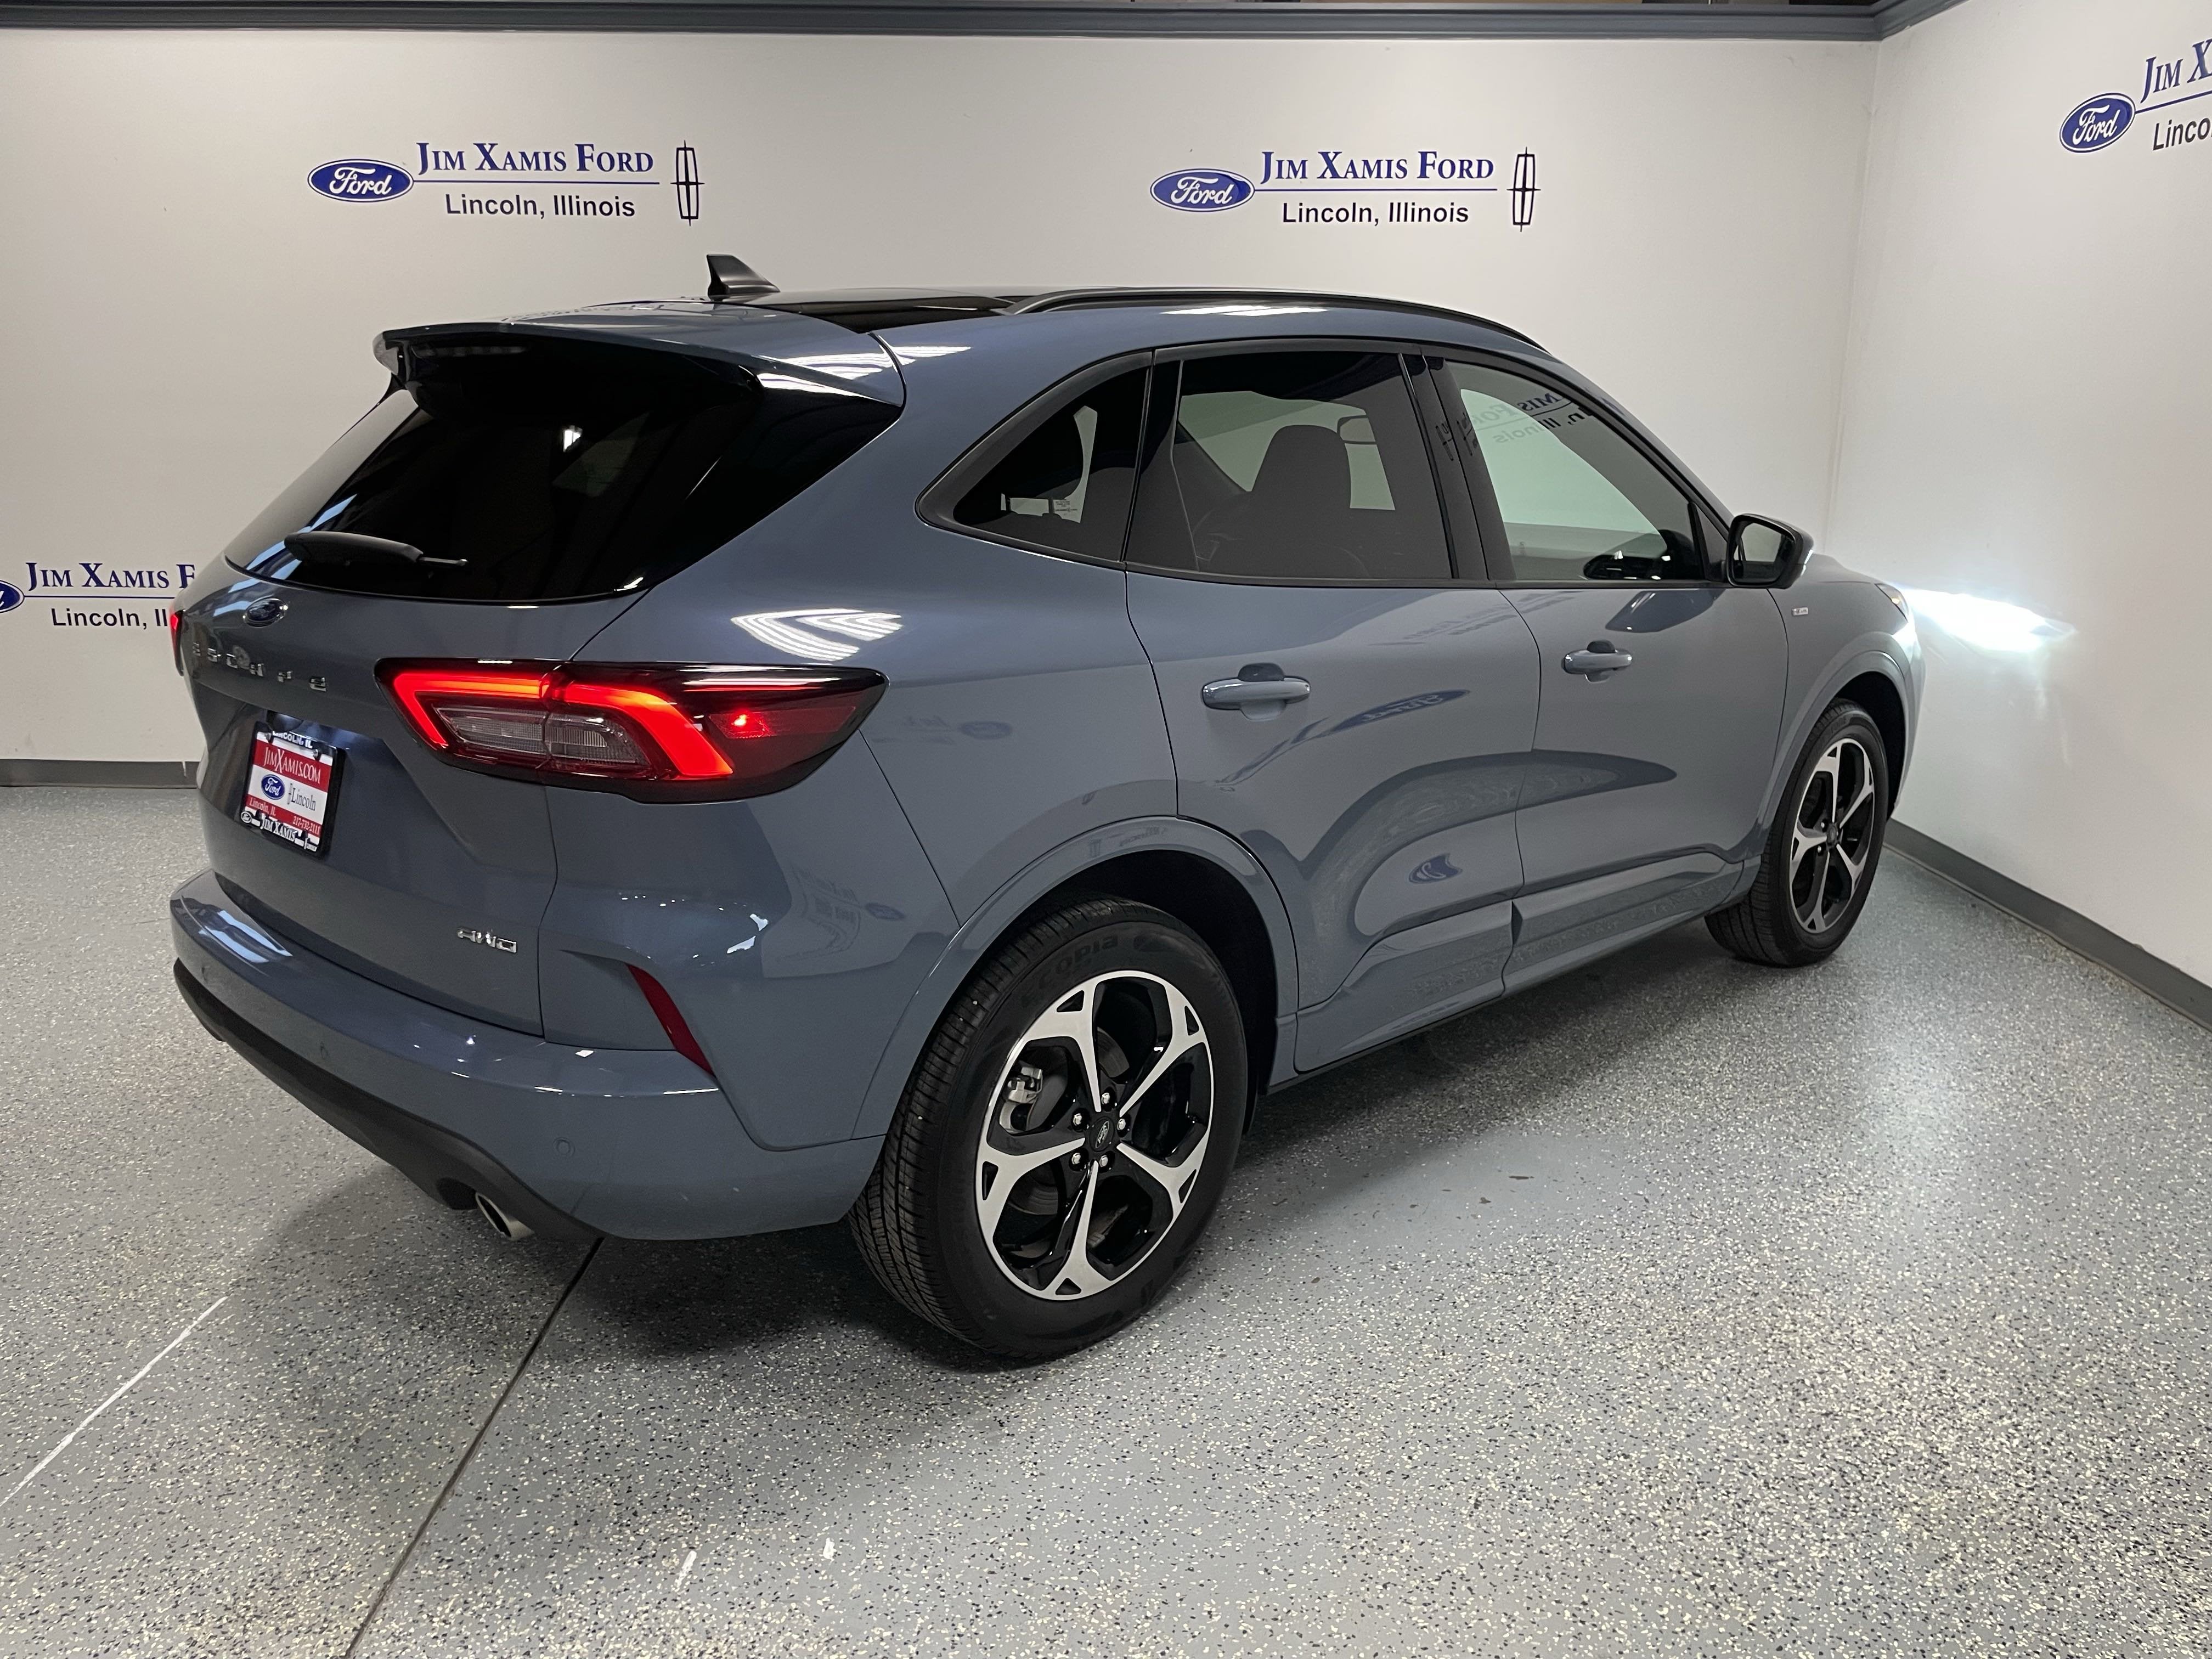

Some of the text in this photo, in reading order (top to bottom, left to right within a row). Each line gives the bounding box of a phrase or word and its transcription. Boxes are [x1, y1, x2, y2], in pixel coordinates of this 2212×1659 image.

[2140, 56, 2183, 104] JIM
[2152, 117, 2212, 151] Linco
[416, 142, 654, 176] JIM XAMIS FORD
[1260, 151, 1494, 184] JIM XAMIS FORD
[445, 194, 636, 219] Lincoln, Illinois
[1283, 202, 1469, 227] Lincoln, Illinois
[26, 562, 74, 591] JIM
[78, 563, 170, 589] XAMIS
[52, 608, 147, 629] Lincoln,
[291, 787, 316, 811] Lincoln
